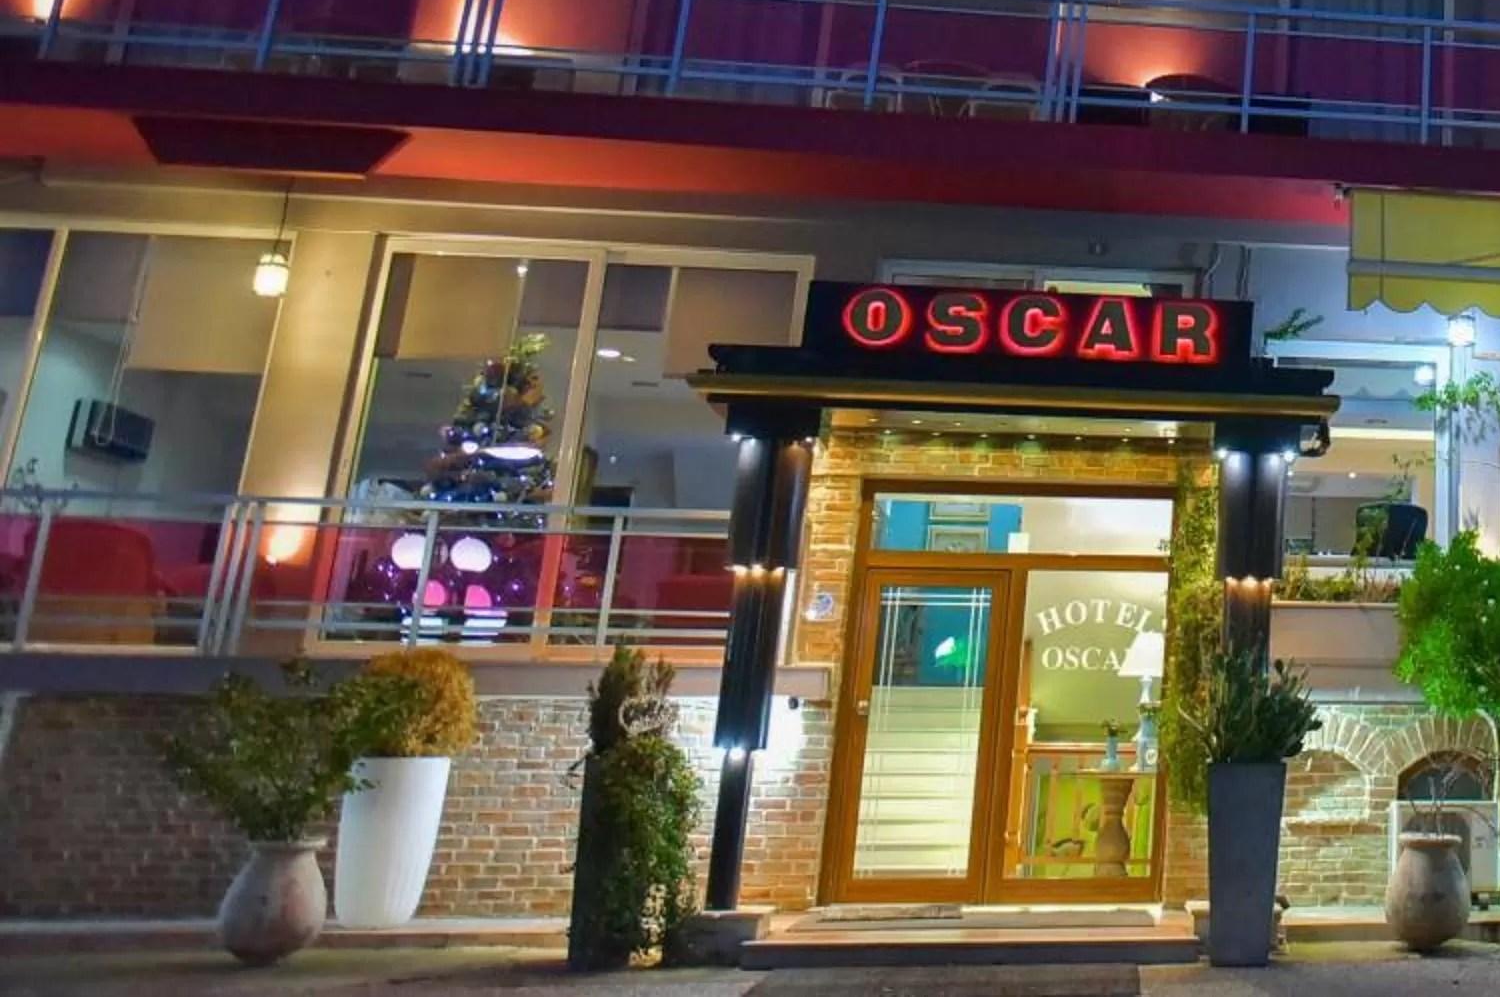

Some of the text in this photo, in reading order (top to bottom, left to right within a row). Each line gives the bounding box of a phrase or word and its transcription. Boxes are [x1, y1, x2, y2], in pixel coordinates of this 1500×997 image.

[844, 288, 1218, 363] OSCAR
[1036, 598, 1152, 636] HOTEL
[1041, 645, 1131, 671] OSCA
